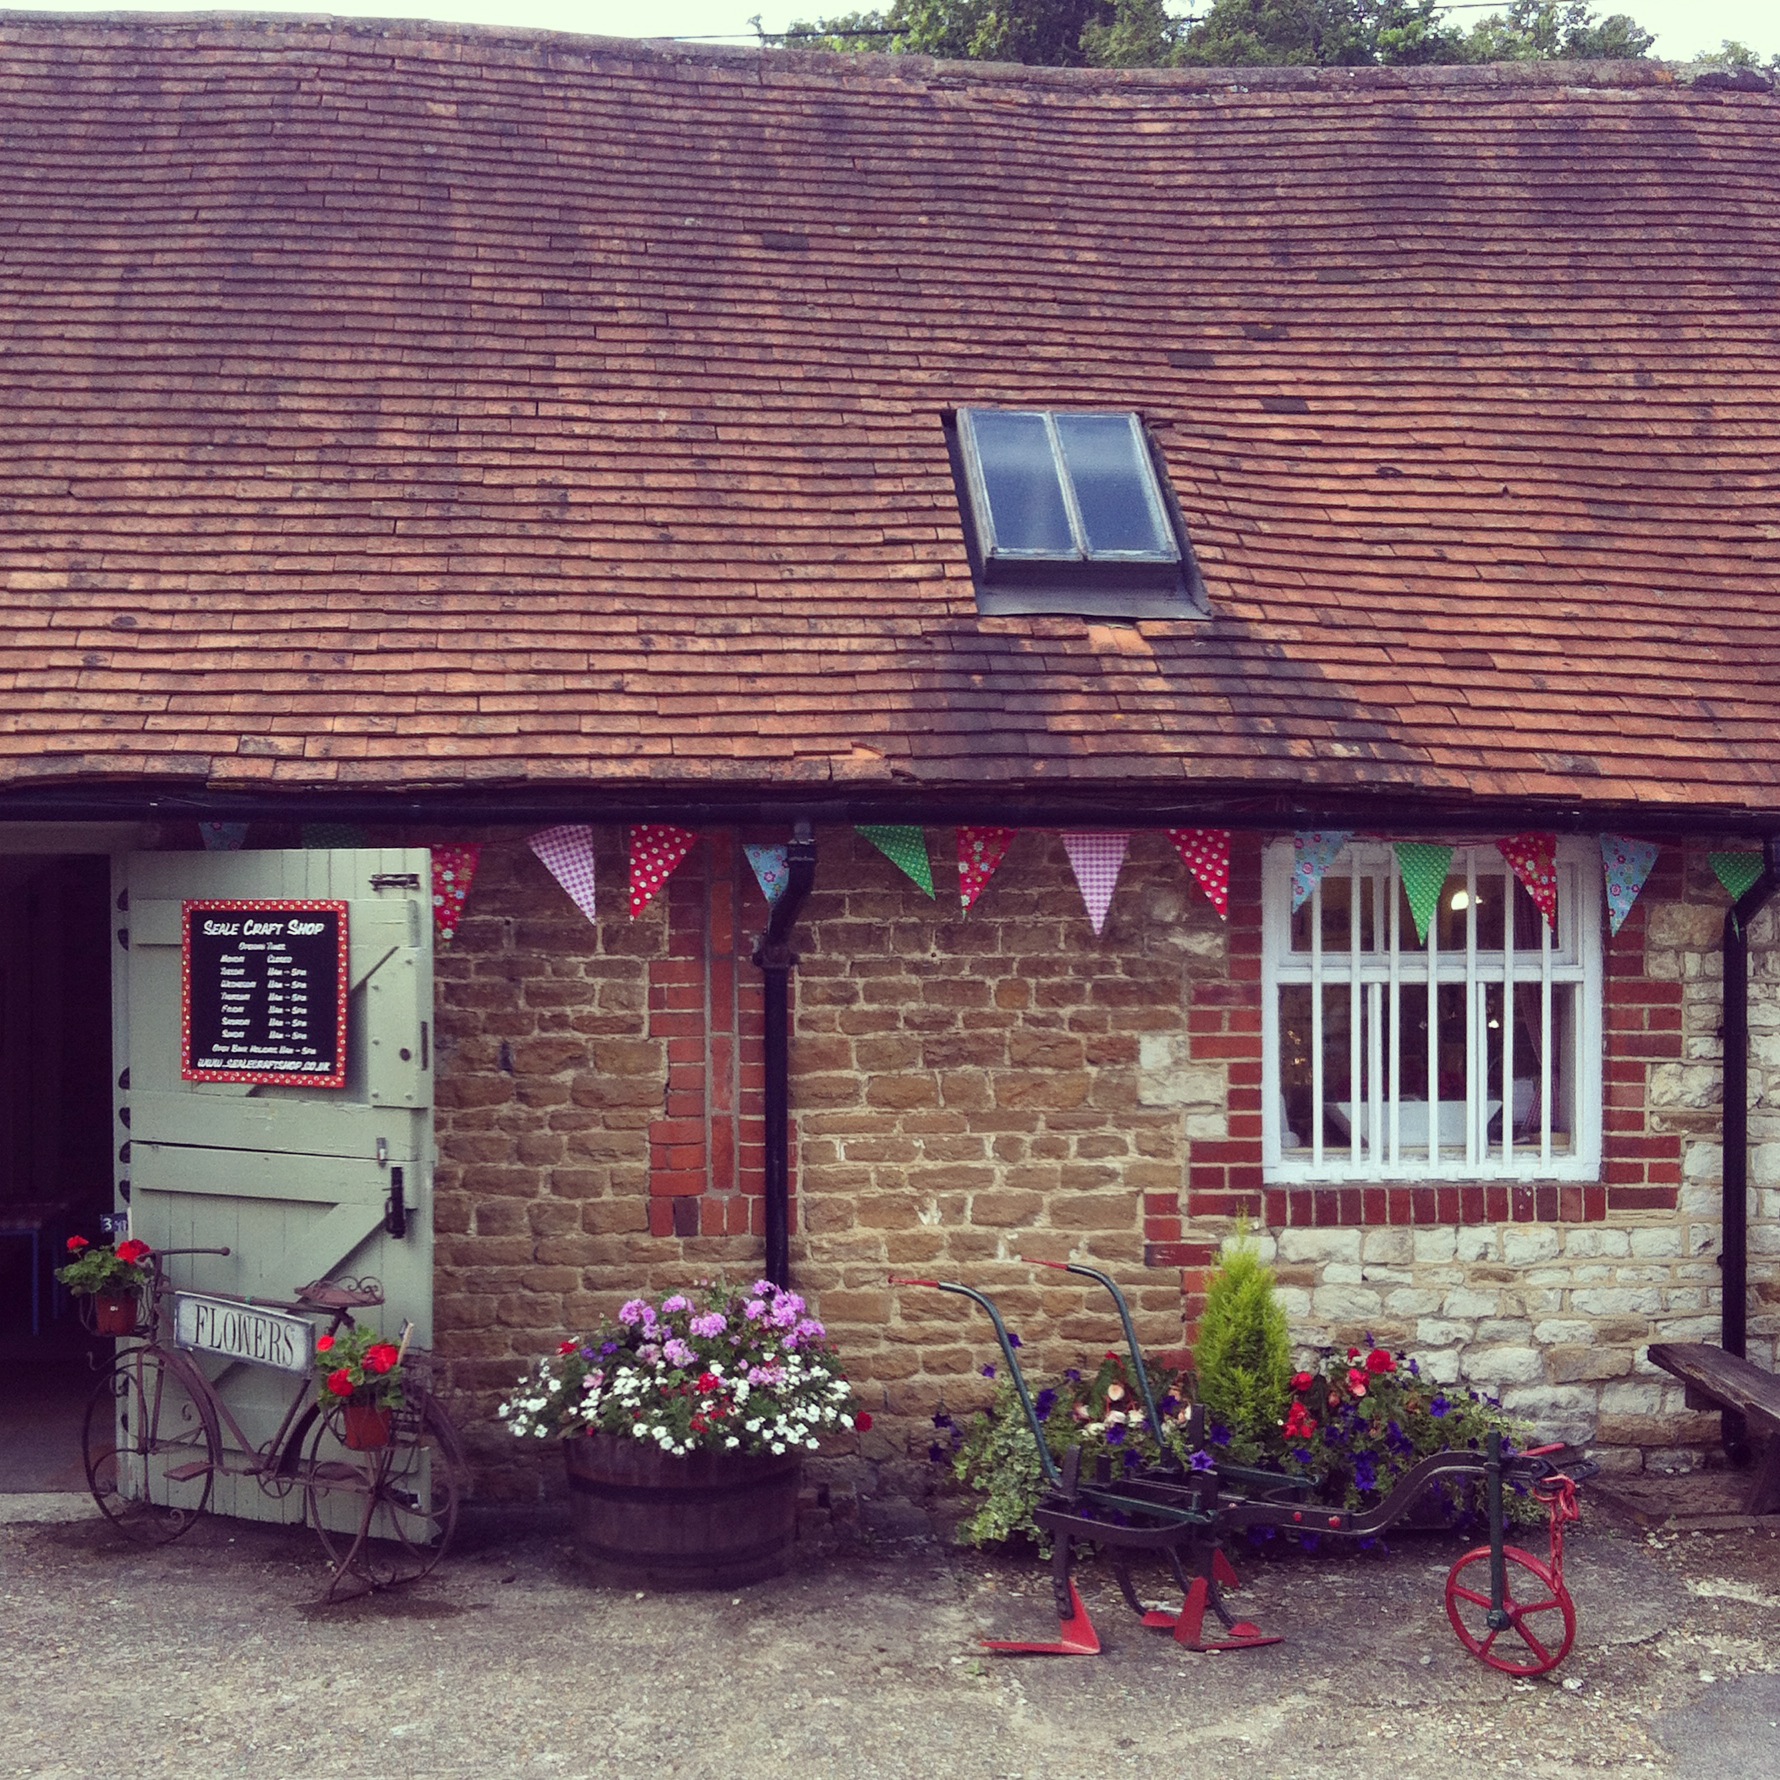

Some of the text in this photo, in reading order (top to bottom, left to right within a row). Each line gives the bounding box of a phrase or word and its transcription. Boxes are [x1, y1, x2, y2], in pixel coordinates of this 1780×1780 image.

[203, 919, 325, 936] SEALE CRAFT SHOP
[194, 1304, 296, 1367] FLOWERS
